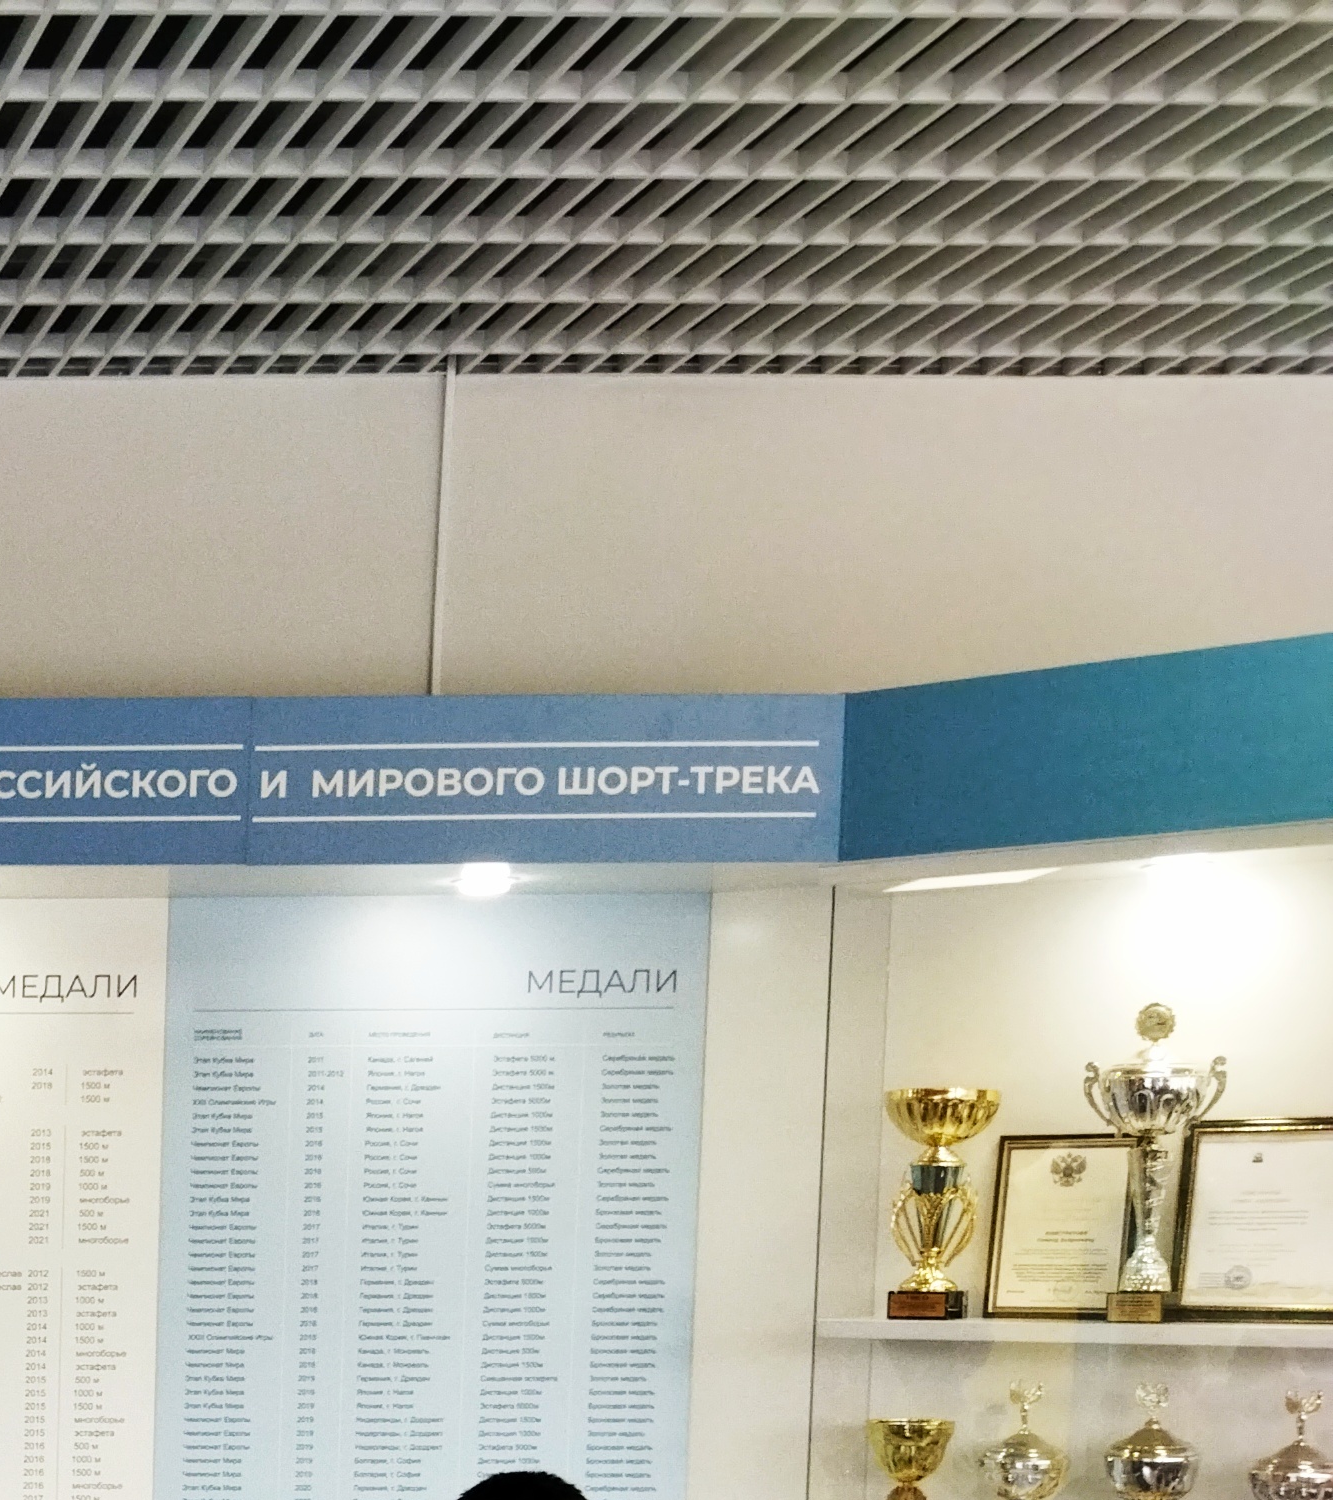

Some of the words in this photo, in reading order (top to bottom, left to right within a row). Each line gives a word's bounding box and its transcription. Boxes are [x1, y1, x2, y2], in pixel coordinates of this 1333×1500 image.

[260, 770, 288, 797] И
[312, 767, 544, 798] МИРОВОГО
[558, 766, 819, 797] ШОРТ-ТРЕКА
[527, 970, 678, 998] МЕДАЛИ
